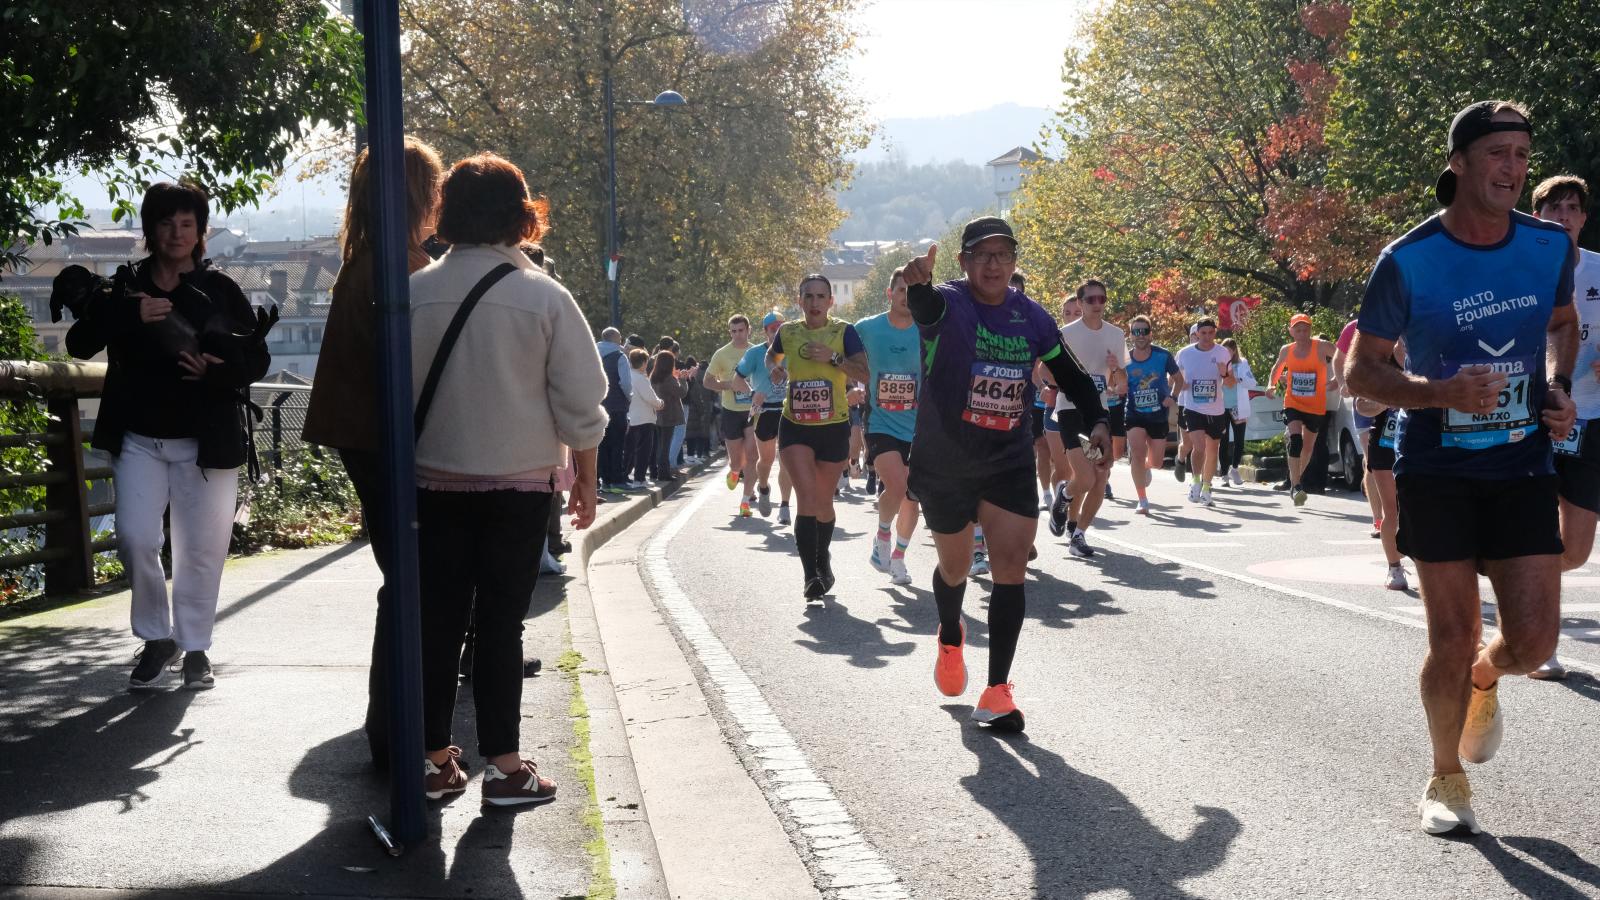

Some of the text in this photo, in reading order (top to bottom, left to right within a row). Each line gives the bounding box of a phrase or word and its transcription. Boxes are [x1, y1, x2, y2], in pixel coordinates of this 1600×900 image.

[1453, 291, 1494, 311] SALTO
[1456, 295, 1538, 325] FOUNDATION
[1460, 324, 1473, 332] .org
[881, 382, 914, 393] 3859
[794, 389, 829, 402] 4269
[1136, 394, 1158, 402] 7761
[1497, 380, 1525, 408] 51
[972, 401, 999, 409] FAUSTO
[1472, 412, 1510, 422] NATXO
